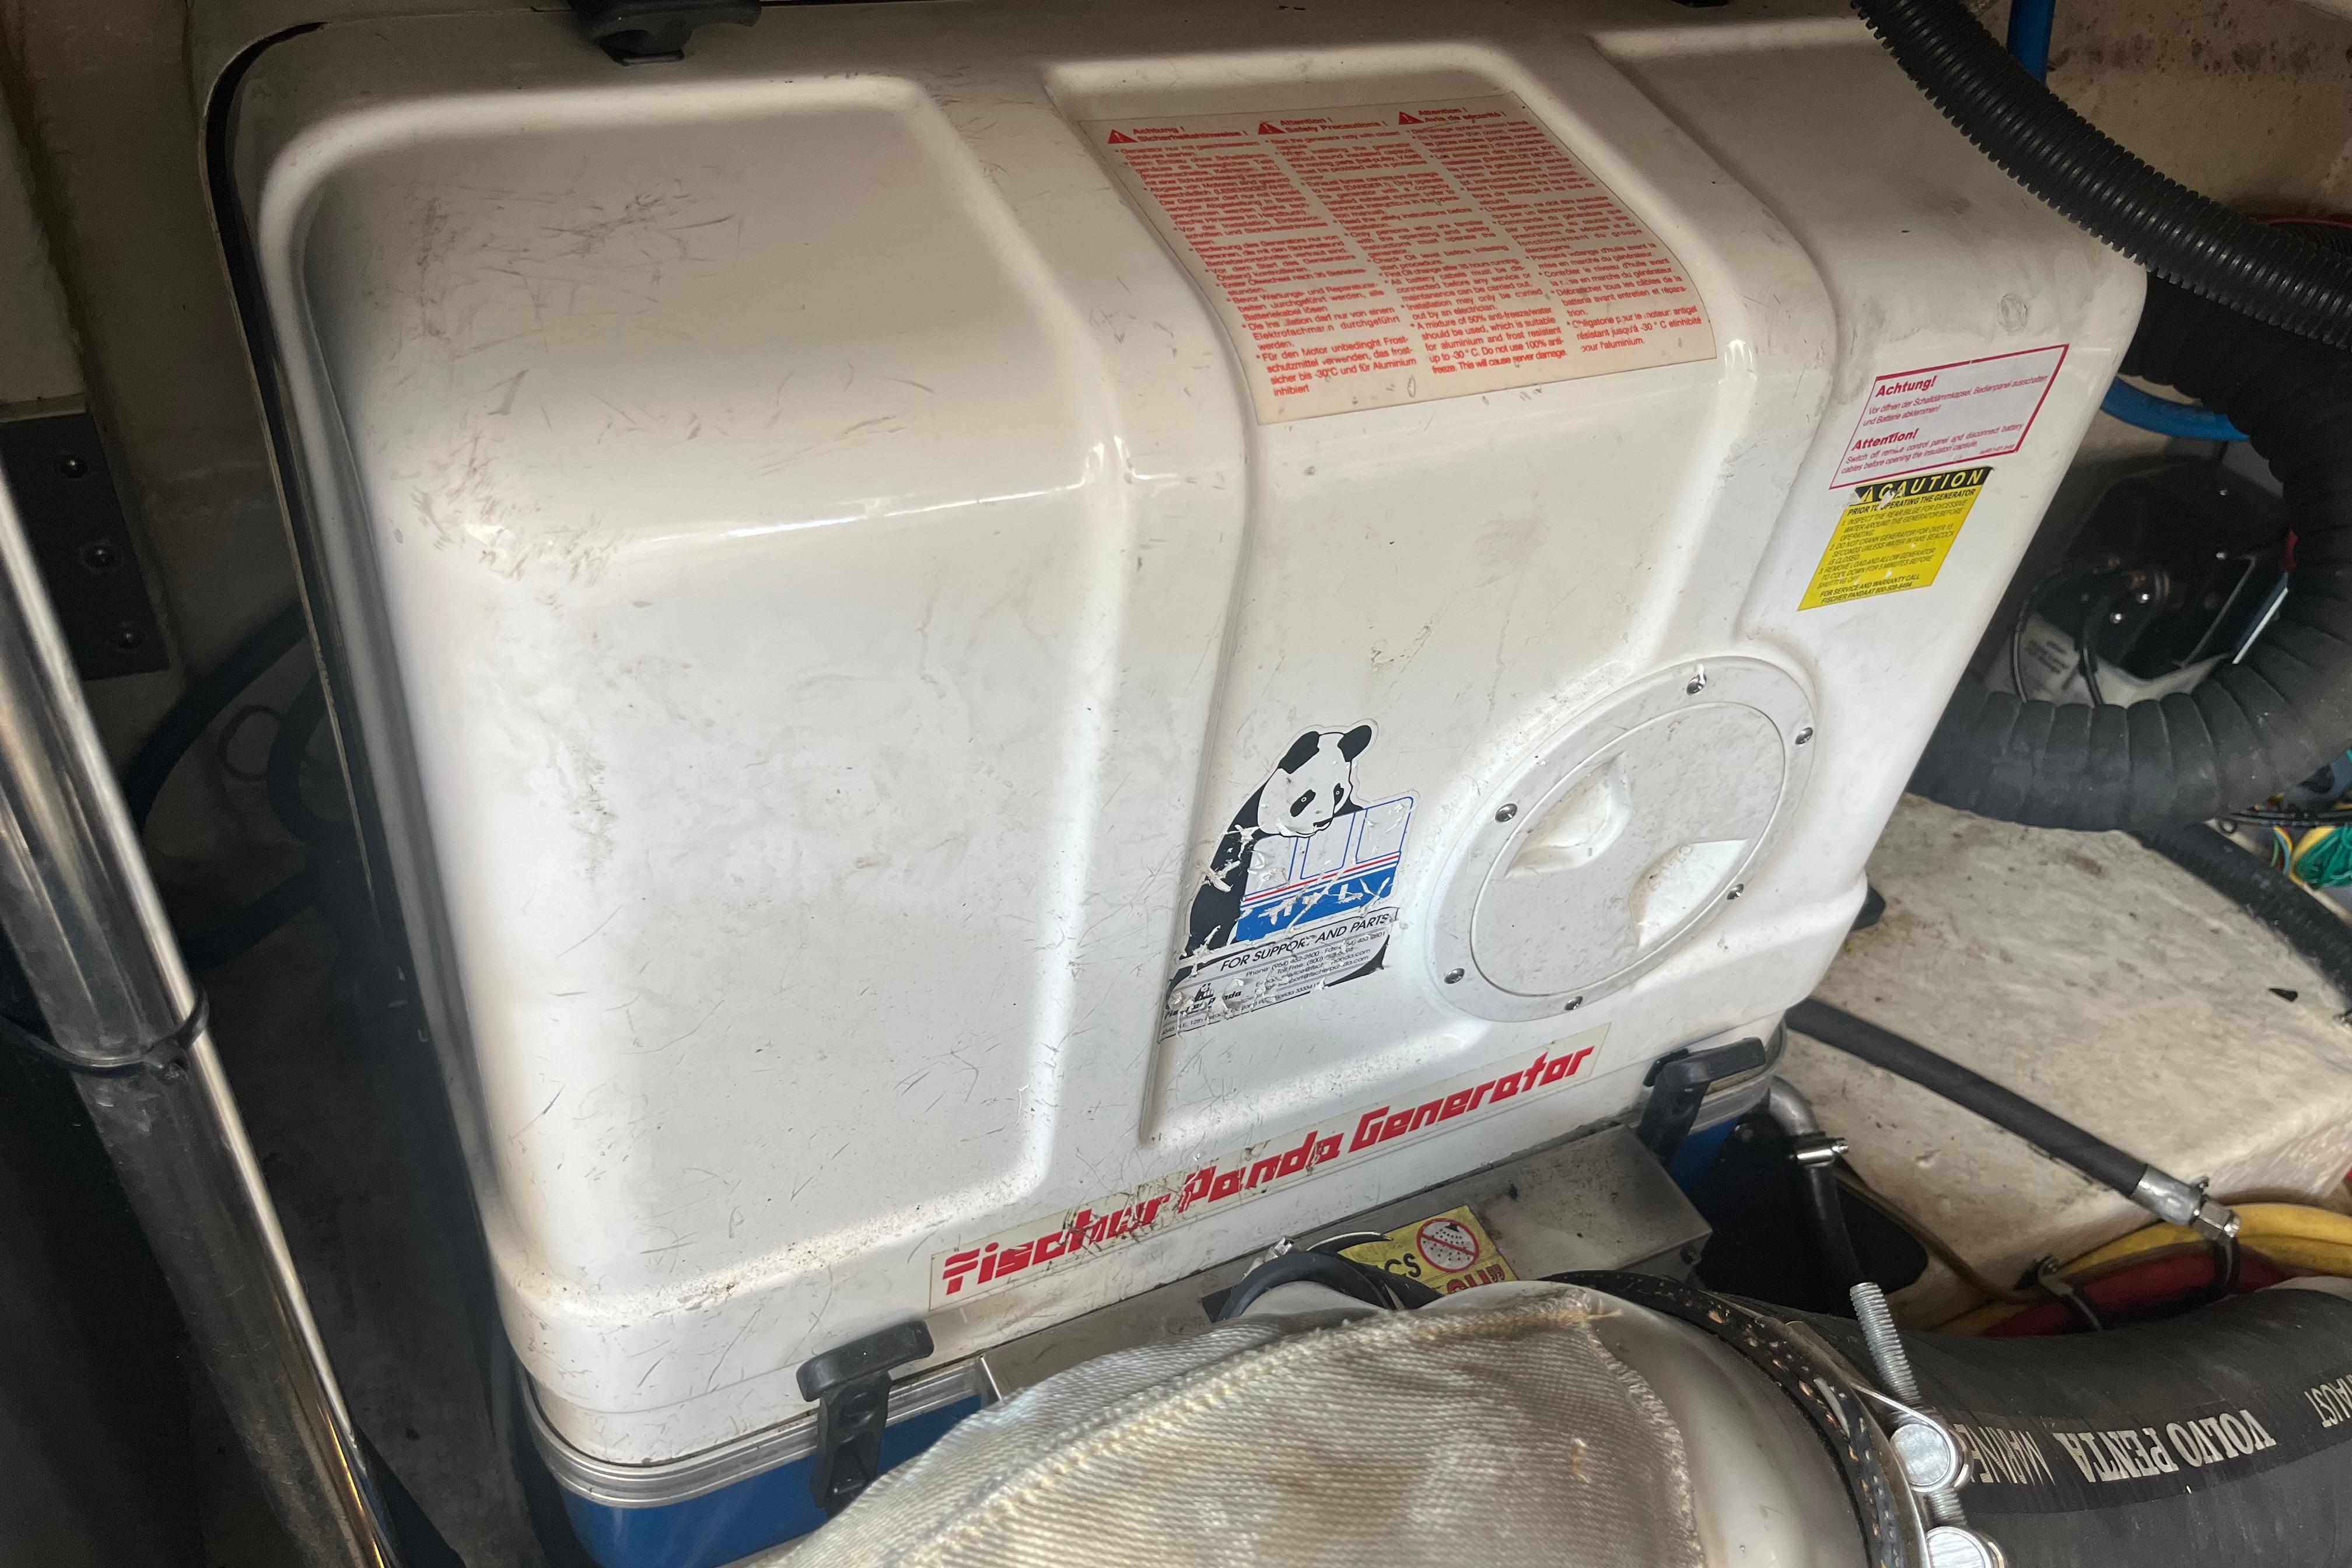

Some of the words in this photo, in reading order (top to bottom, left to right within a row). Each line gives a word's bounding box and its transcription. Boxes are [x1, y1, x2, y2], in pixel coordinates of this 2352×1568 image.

[1422, 330, 1450, 341] should
[1452, 328, 1464, 337] be
[1490, 321, 1514, 331] which
[1425, 343, 1437, 351] for
[1488, 335, 1503, 344] and
[1506, 331, 1525, 340] frost
[1262, 352, 1278, 362] Für
[1282, 351, 1299, 359] den
[1373, 350, 1389, 359] das
[1429, 355, 1440, 364] up
[1482, 347, 1494, 355] Do
[1496, 345, 1508, 354] not
[1458, 362, 1475, 371] This
[1489, 358, 1511, 366] cause
[1270, 374, 1297, 385] sicher
[1298, 370, 1312, 380] bis
[1340, 365, 1357, 374] und
[1359, 363, 1371, 372] für
[1373, 357, 1417, 370] Aluminium
[1875, 375, 1937, 397] Achtung!
[1852, 428, 1919, 450] Attention!
[1881, 447, 1904, 456] reme
[1847, 506, 1870, 516] PRIOR
[1920, 495, 1934, 503] THE
[1934, 488, 1976, 501] GENERATOR
[1220, 954, 1250, 971] FOR
[1252, 935, 1316, 961] SUPPOR
[1314, 926, 1347, 943] AND
[1350, 914, 1389, 933] PARTS
[942, 1193, 1171, 1296] Fischer
[1177, 1130, 1344, 1214] Panda
[1348, 1045, 1595, 1153] Generator
[1384, 1253, 1422, 1278] CS
[2304, 1374, 2352, 1428] AUST
[2165, 1409, 2277, 1468] VOLVO
[2053, 1426, 2180, 1483] PENTA
